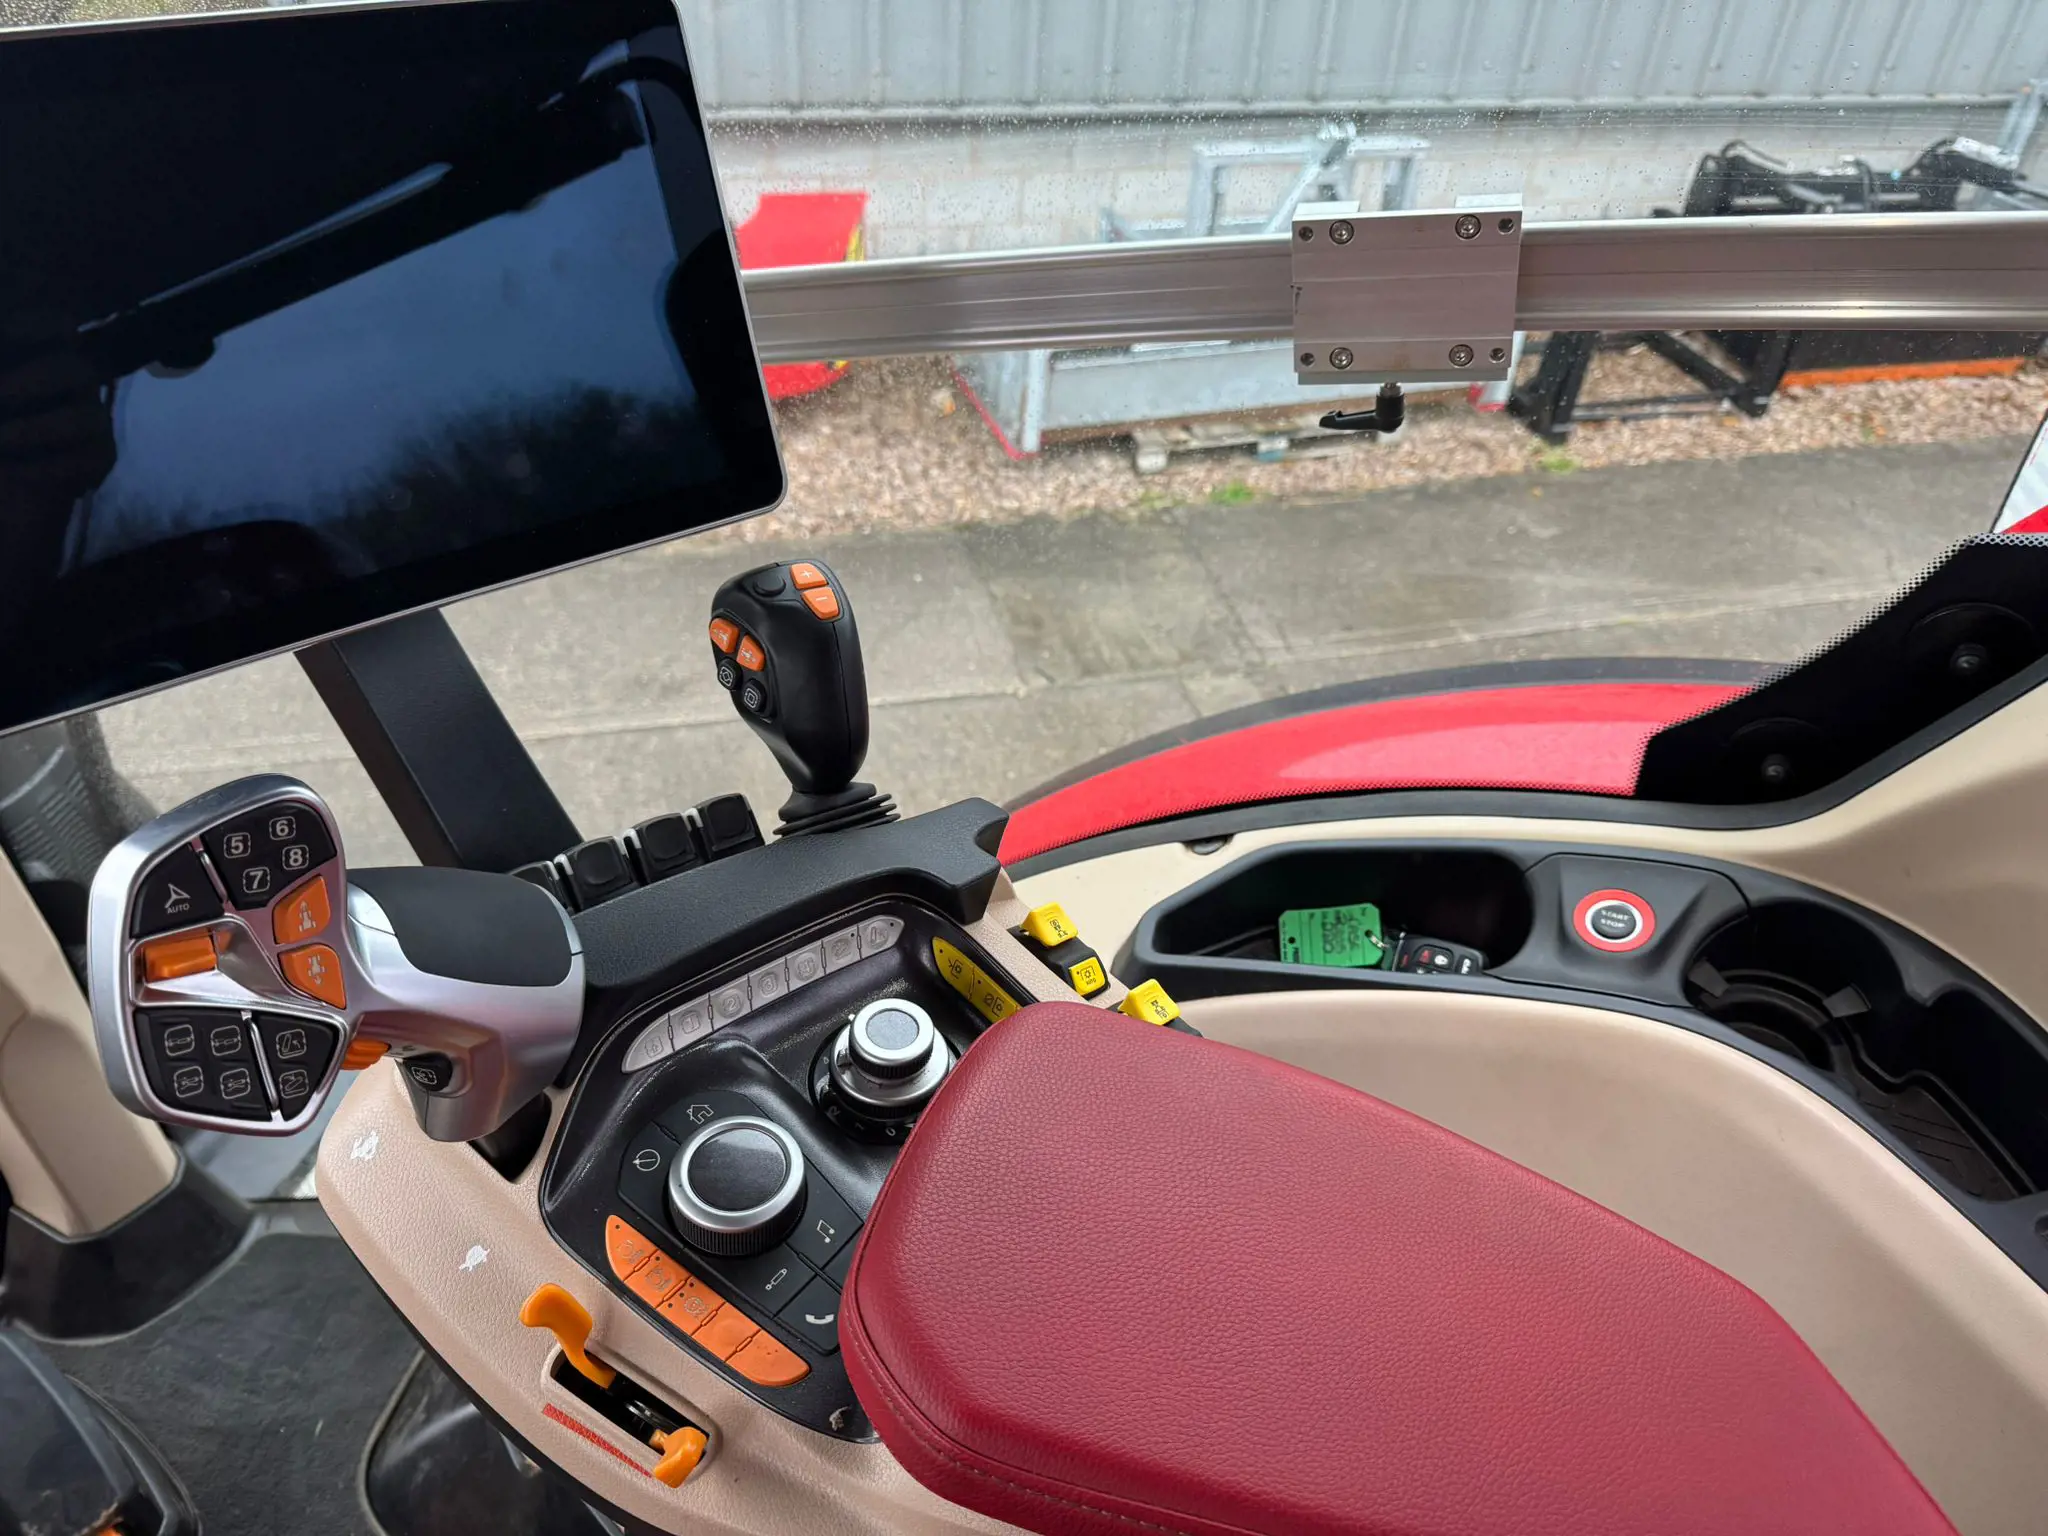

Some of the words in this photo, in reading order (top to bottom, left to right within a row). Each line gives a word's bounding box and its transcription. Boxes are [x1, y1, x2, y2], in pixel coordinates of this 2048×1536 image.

[276, 820, 289, 836] 6
[231, 836, 243, 854] 5
[289, 849, 303, 866] 8
[250, 871, 263, 889] 7
[167, 904, 190, 914] AUTO
[1601, 909, 1630, 920] START
[1601, 919, 1625, 928] STOP
